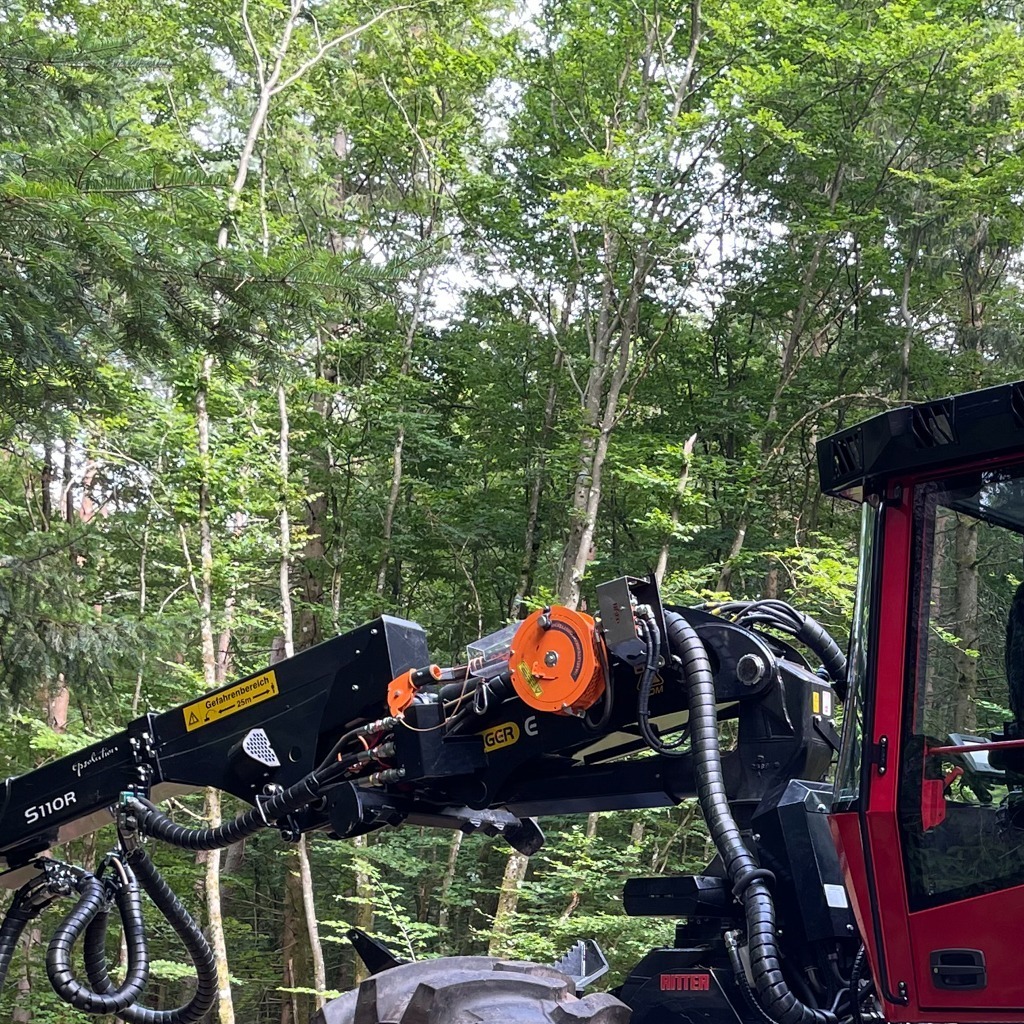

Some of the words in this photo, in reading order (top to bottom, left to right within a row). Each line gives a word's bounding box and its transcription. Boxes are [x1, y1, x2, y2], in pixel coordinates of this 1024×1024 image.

[205, 676, 270, 709] Gefahrenbereich
[236, 697, 252, 708] 25m
[24, 791, 77, 824] S110R
[660, 974, 709, 991] RITTER
